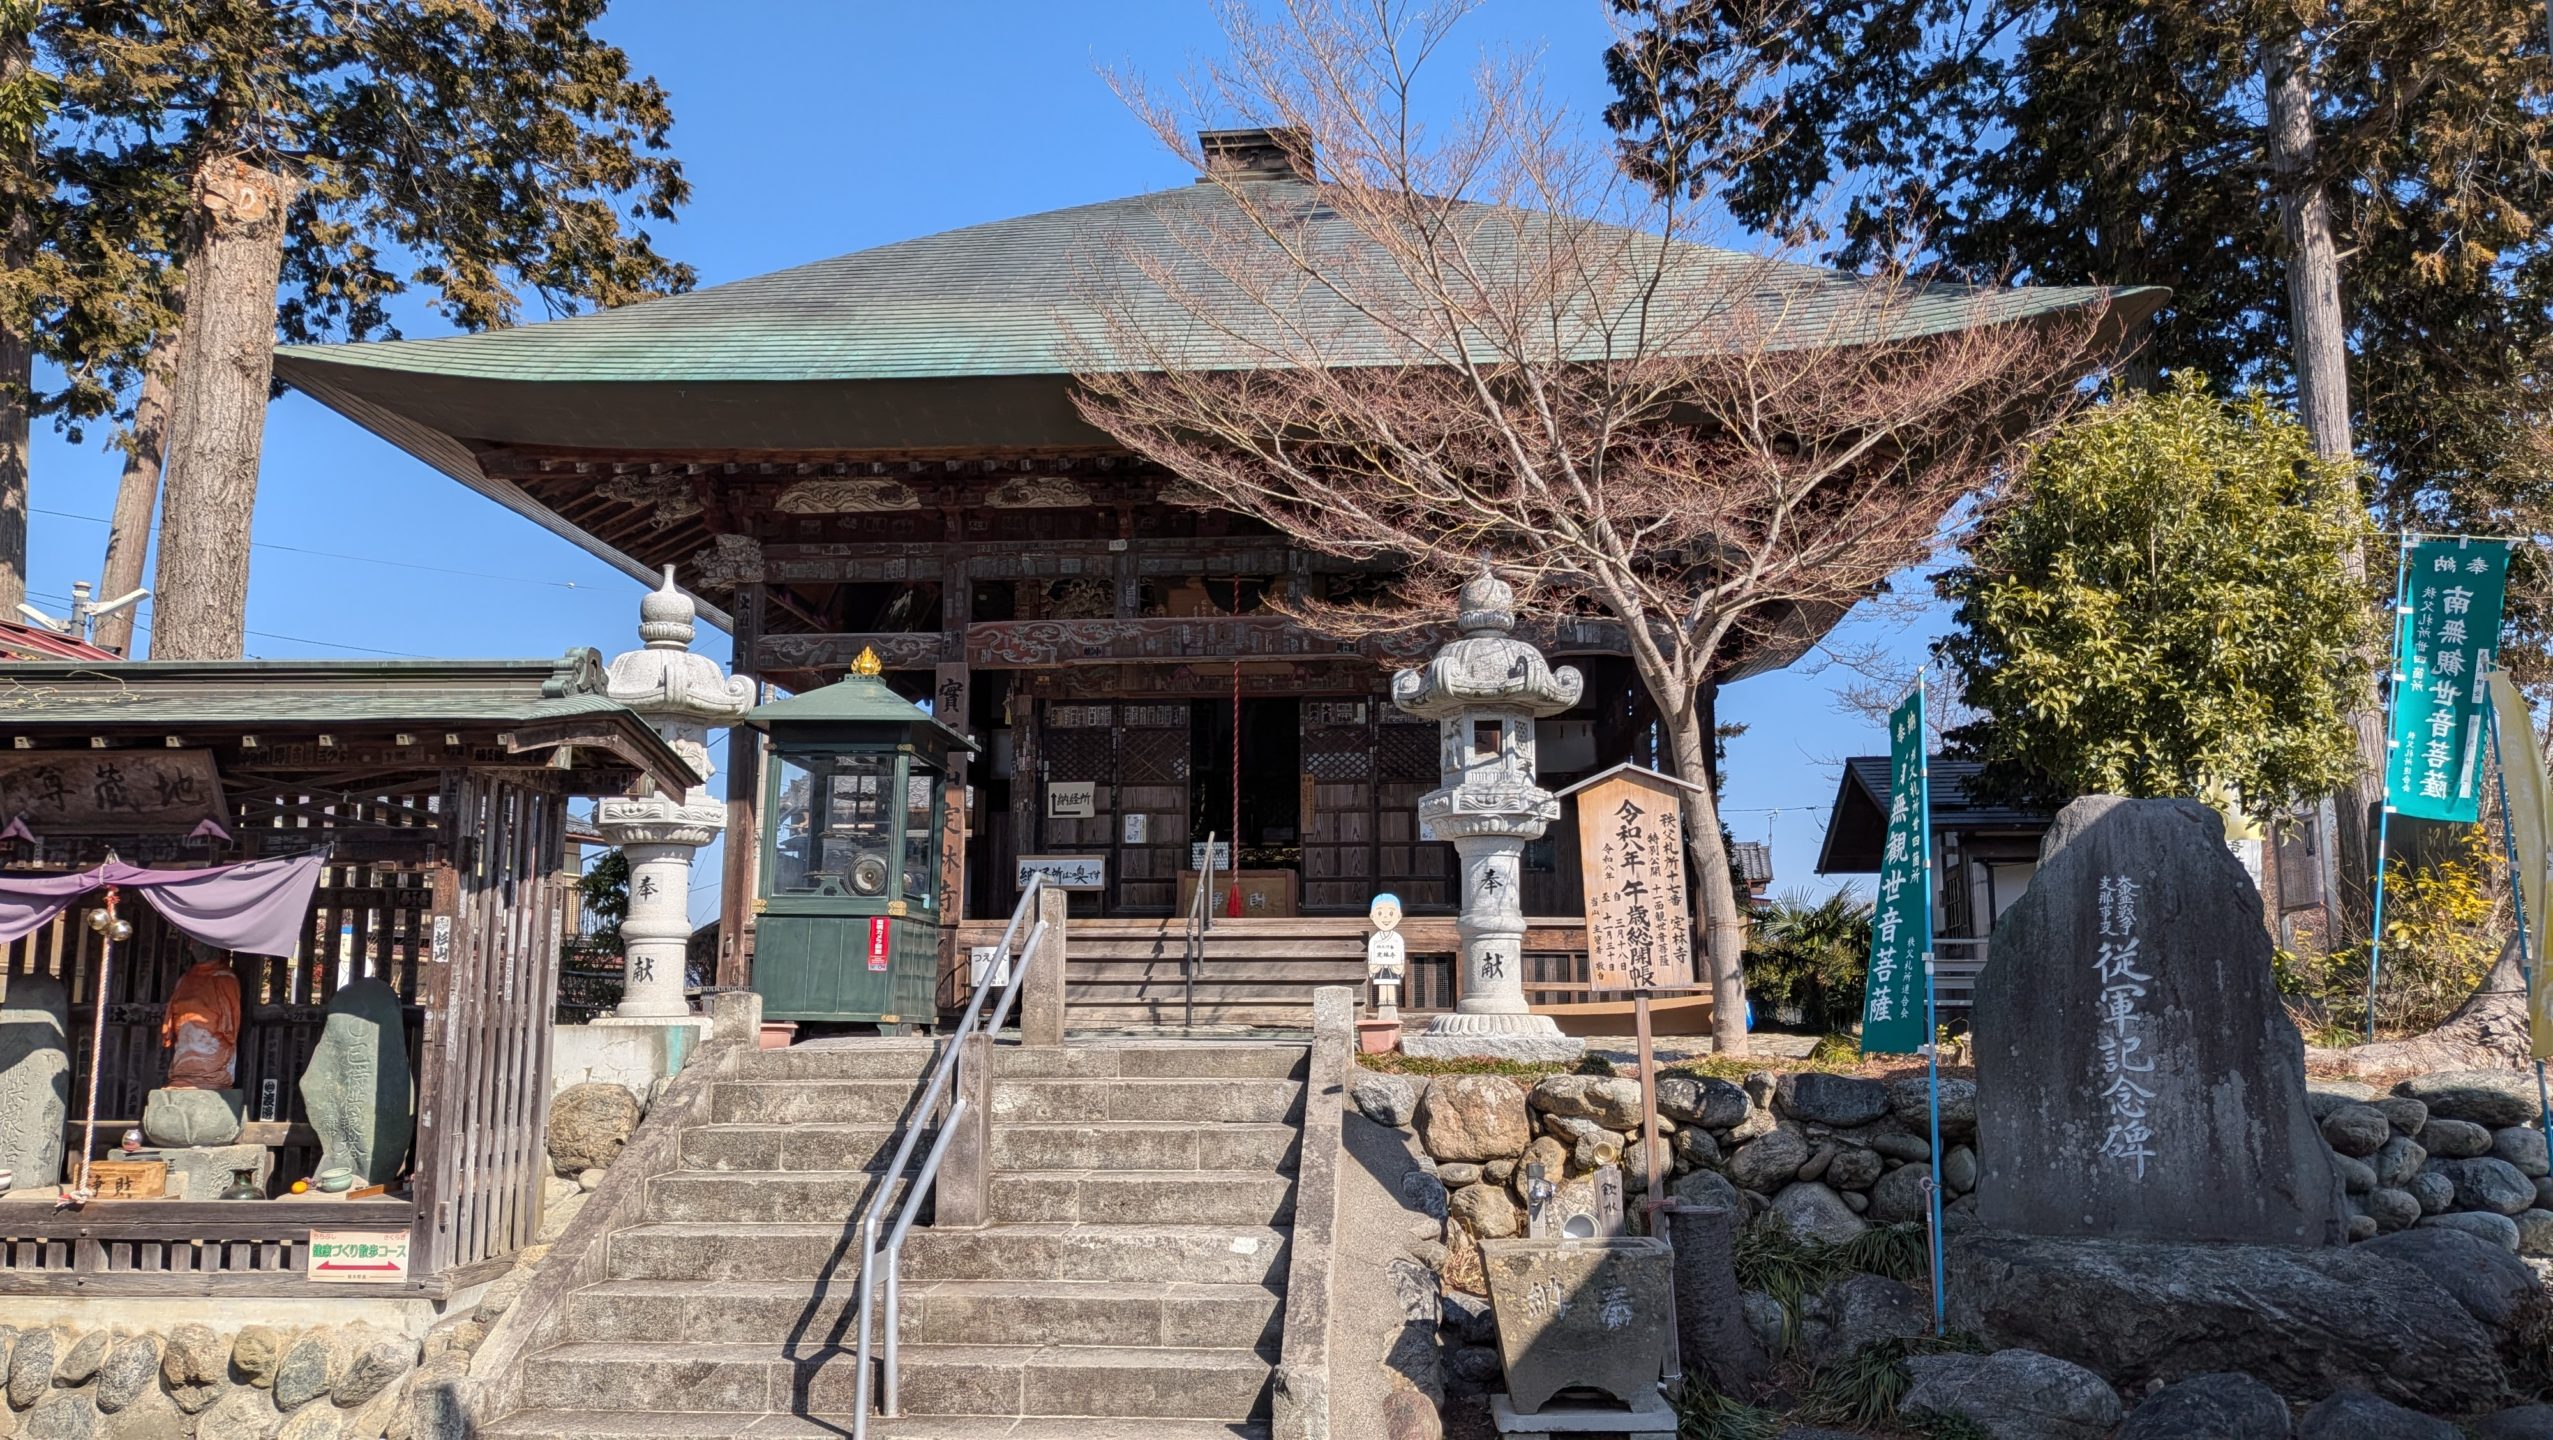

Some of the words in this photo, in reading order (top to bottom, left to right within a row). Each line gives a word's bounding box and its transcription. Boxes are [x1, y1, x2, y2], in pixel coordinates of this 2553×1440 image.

[1601, 842, 1615, 881] 令和八年
[1614, 798, 1646, 876] 令和八年
[1659, 812, 1682, 907] 秩父札所十七番
[635, 875, 659, 902] 奉
[1478, 867, 1503, 895] 奉
[1481, 951, 1504, 979] 献
[1602, 911, 1616, 972] 十一月三十日
[1614, 918, 1629, 971] 三月十八日
[1670, 915, 1688, 965] 定林寺
[632, 956, 655, 983] 献
[2091, 937, 2158, 1179] 従軍記念碑
